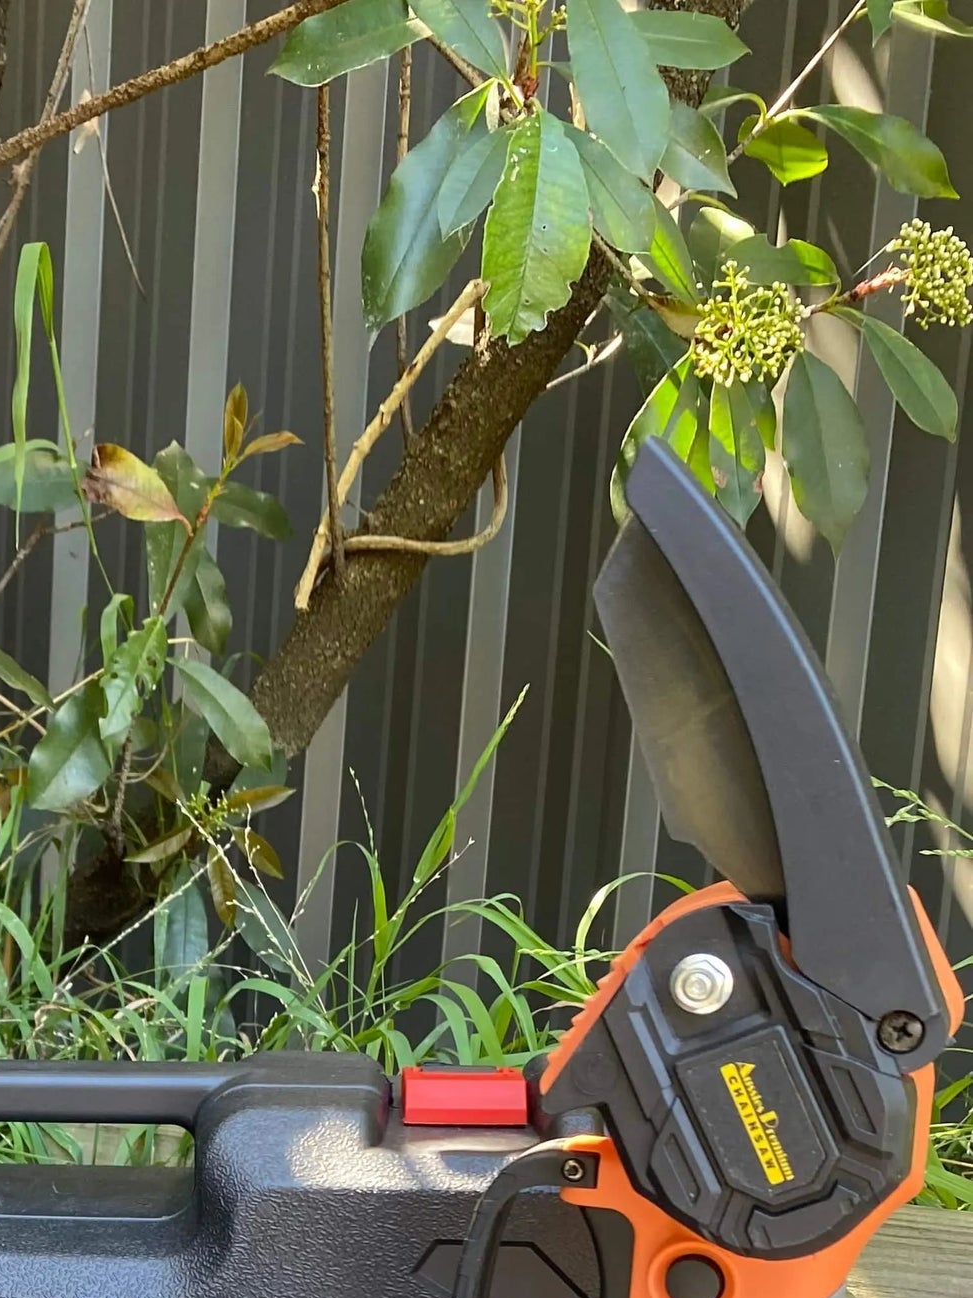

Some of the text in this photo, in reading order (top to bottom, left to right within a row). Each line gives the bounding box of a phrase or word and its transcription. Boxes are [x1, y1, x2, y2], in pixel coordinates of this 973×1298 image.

[727, 1075, 777, 1169] CHAINSAW
[735, 1061, 795, 1181] Aussies Premium
